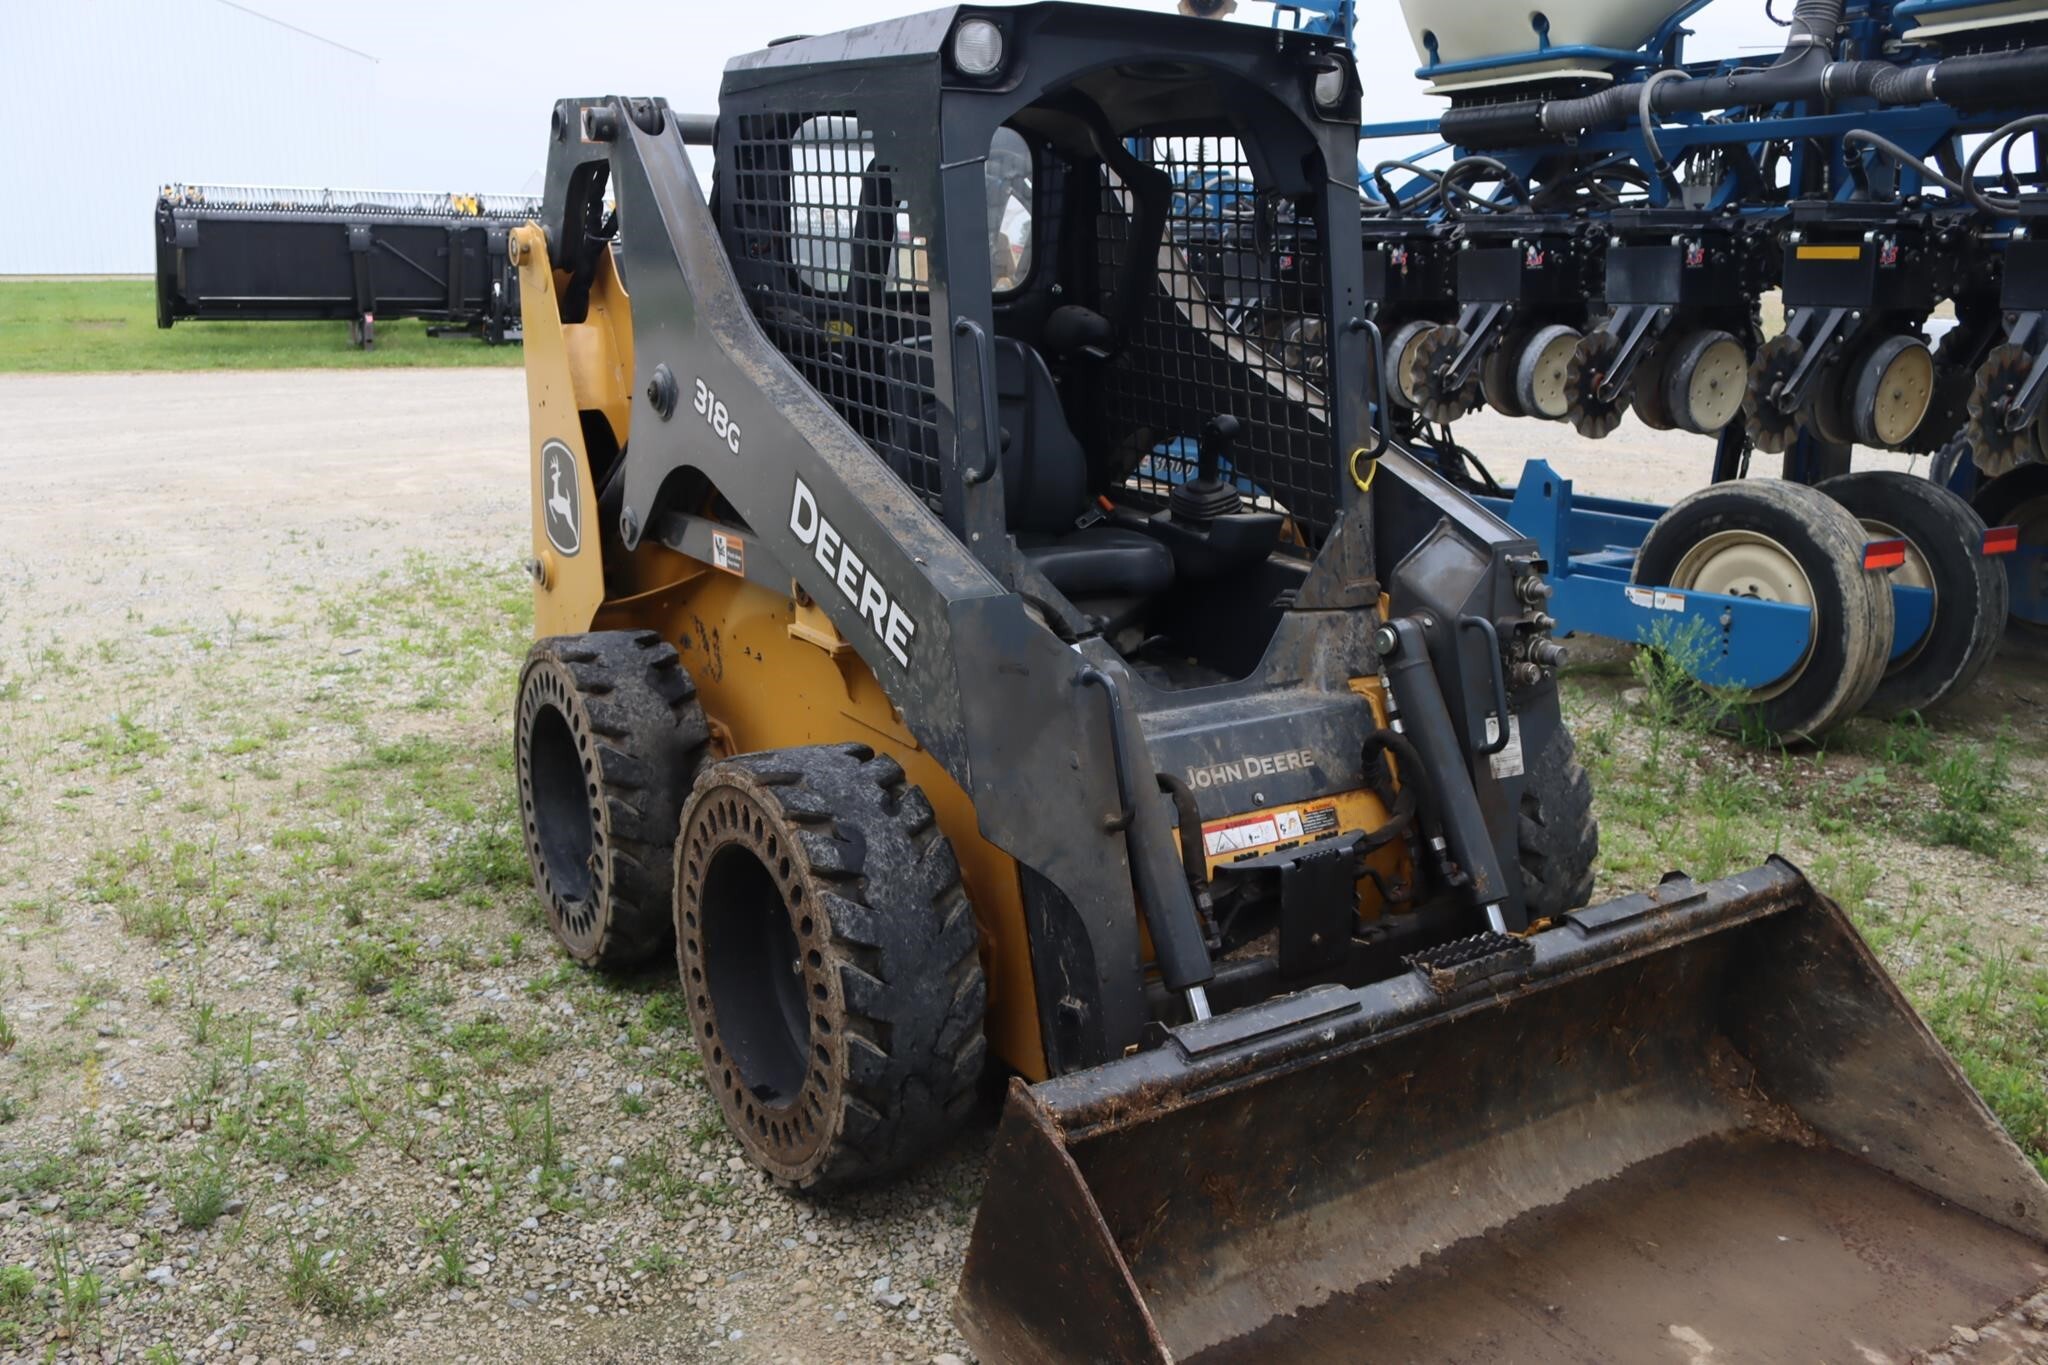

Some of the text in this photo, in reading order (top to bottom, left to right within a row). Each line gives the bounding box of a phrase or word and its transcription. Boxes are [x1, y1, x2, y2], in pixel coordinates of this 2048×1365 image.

[693, 377, 741, 455] 318G
[790, 477, 915, 668] DEERE
[1186, 749, 1315, 791] JOHN DEERE
